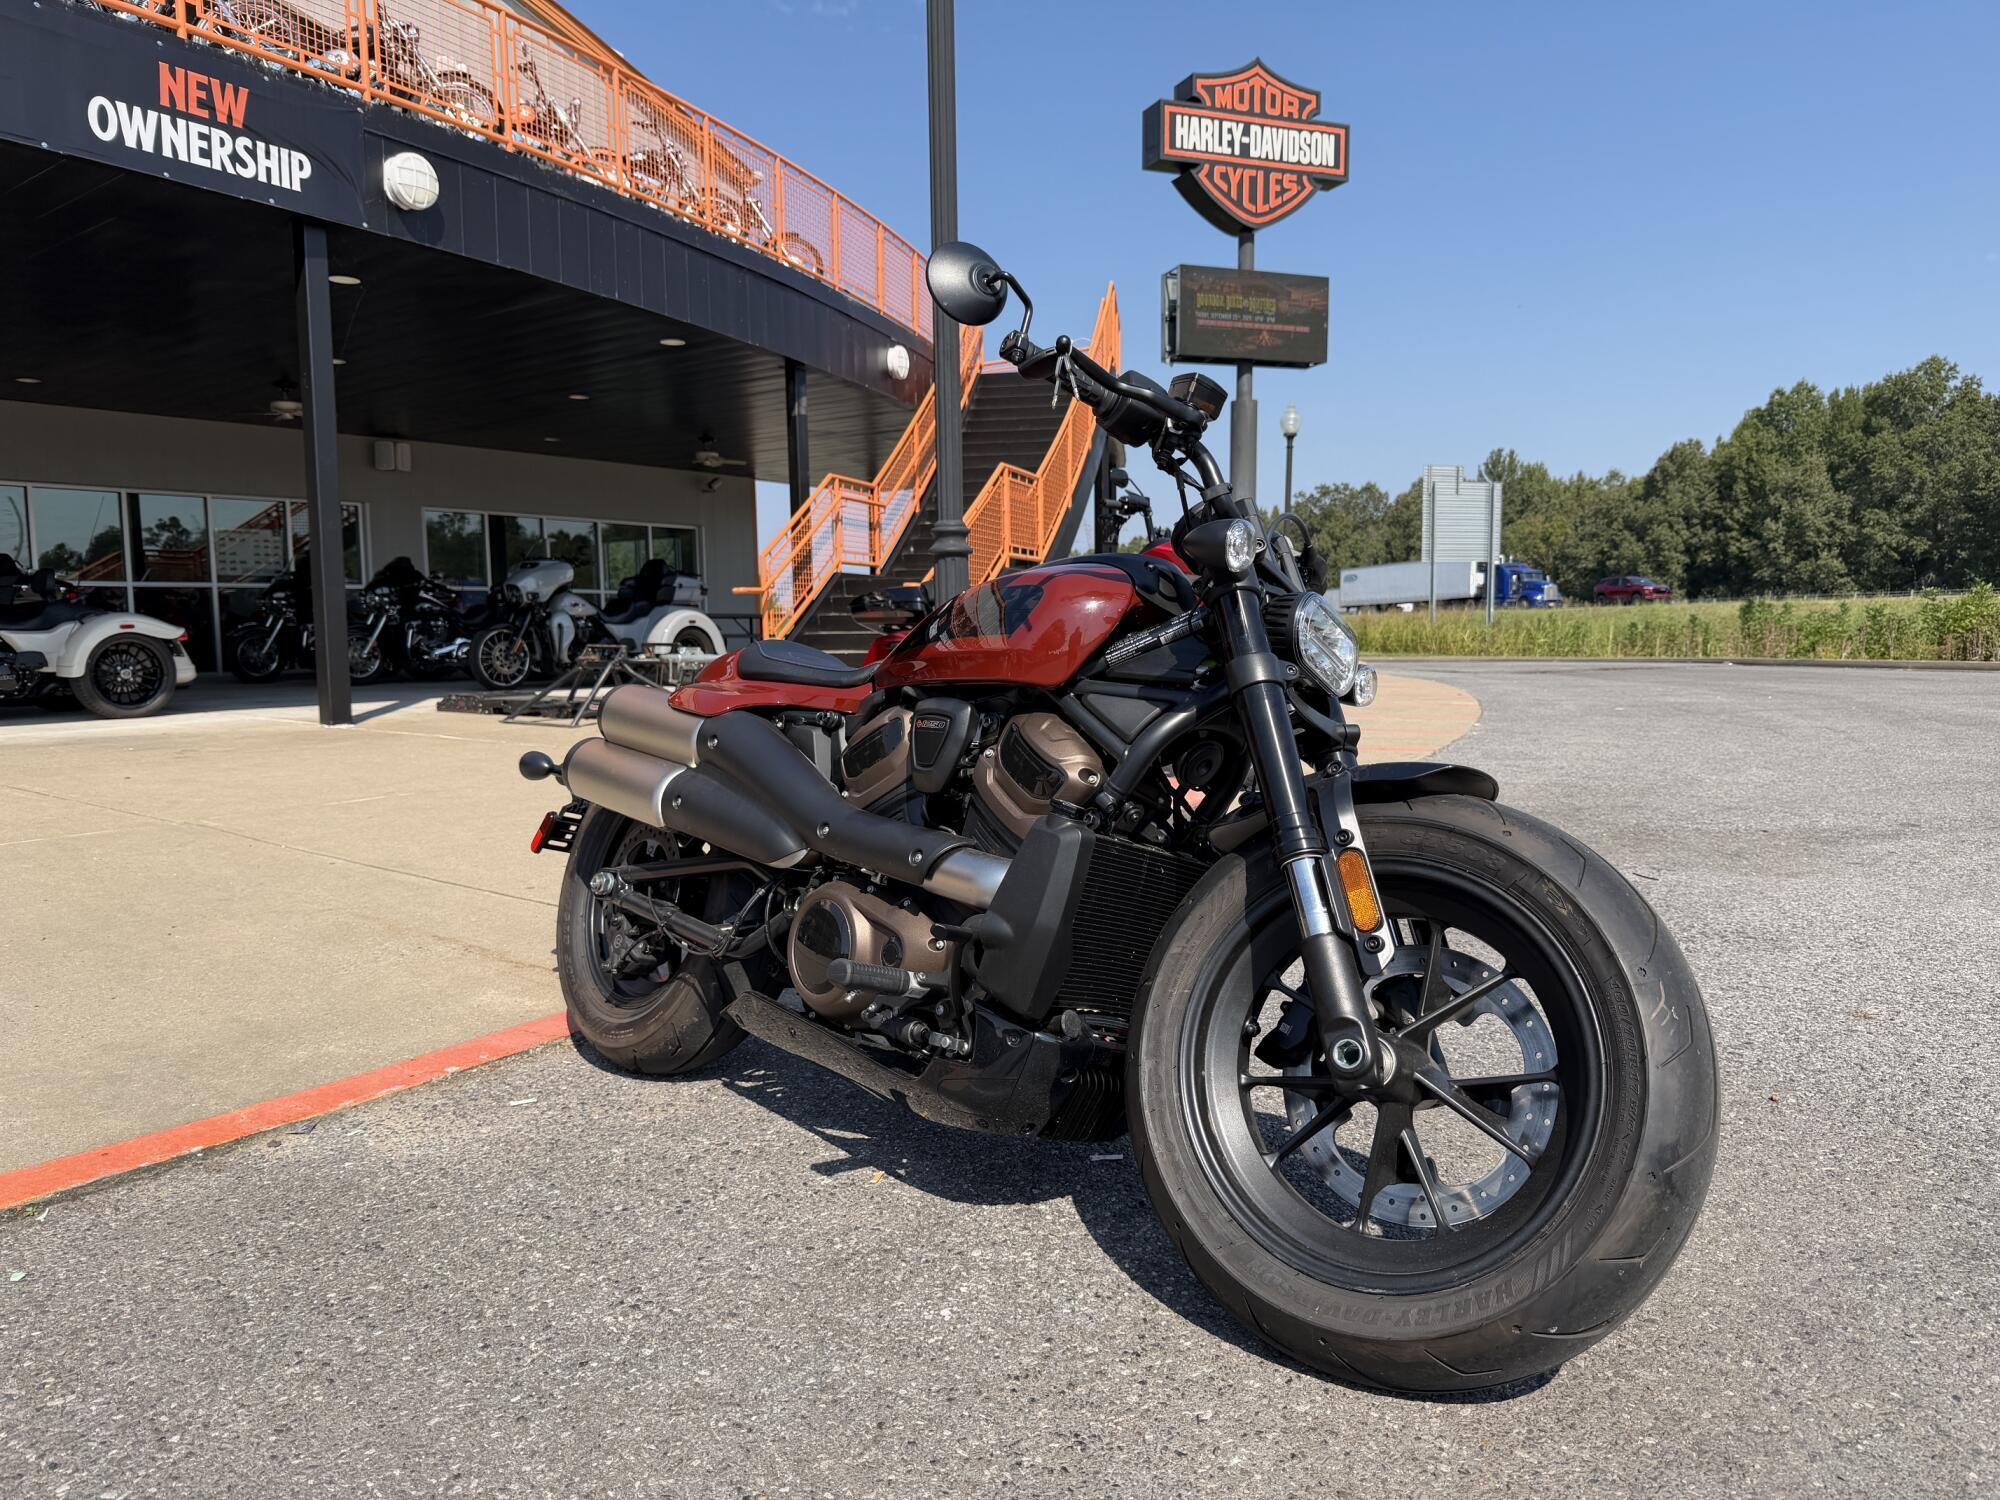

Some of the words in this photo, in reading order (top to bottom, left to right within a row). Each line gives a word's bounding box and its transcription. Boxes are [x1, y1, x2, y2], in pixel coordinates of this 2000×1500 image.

[159, 61, 249, 129] NEW
[1214, 75, 1300, 119] MOTOR
[87, 95, 312, 192] OWNERSHIP
[1175, 114, 1336, 167] HARLEY-DAVIDSON
[1213, 165, 1298, 214] CYCLES
